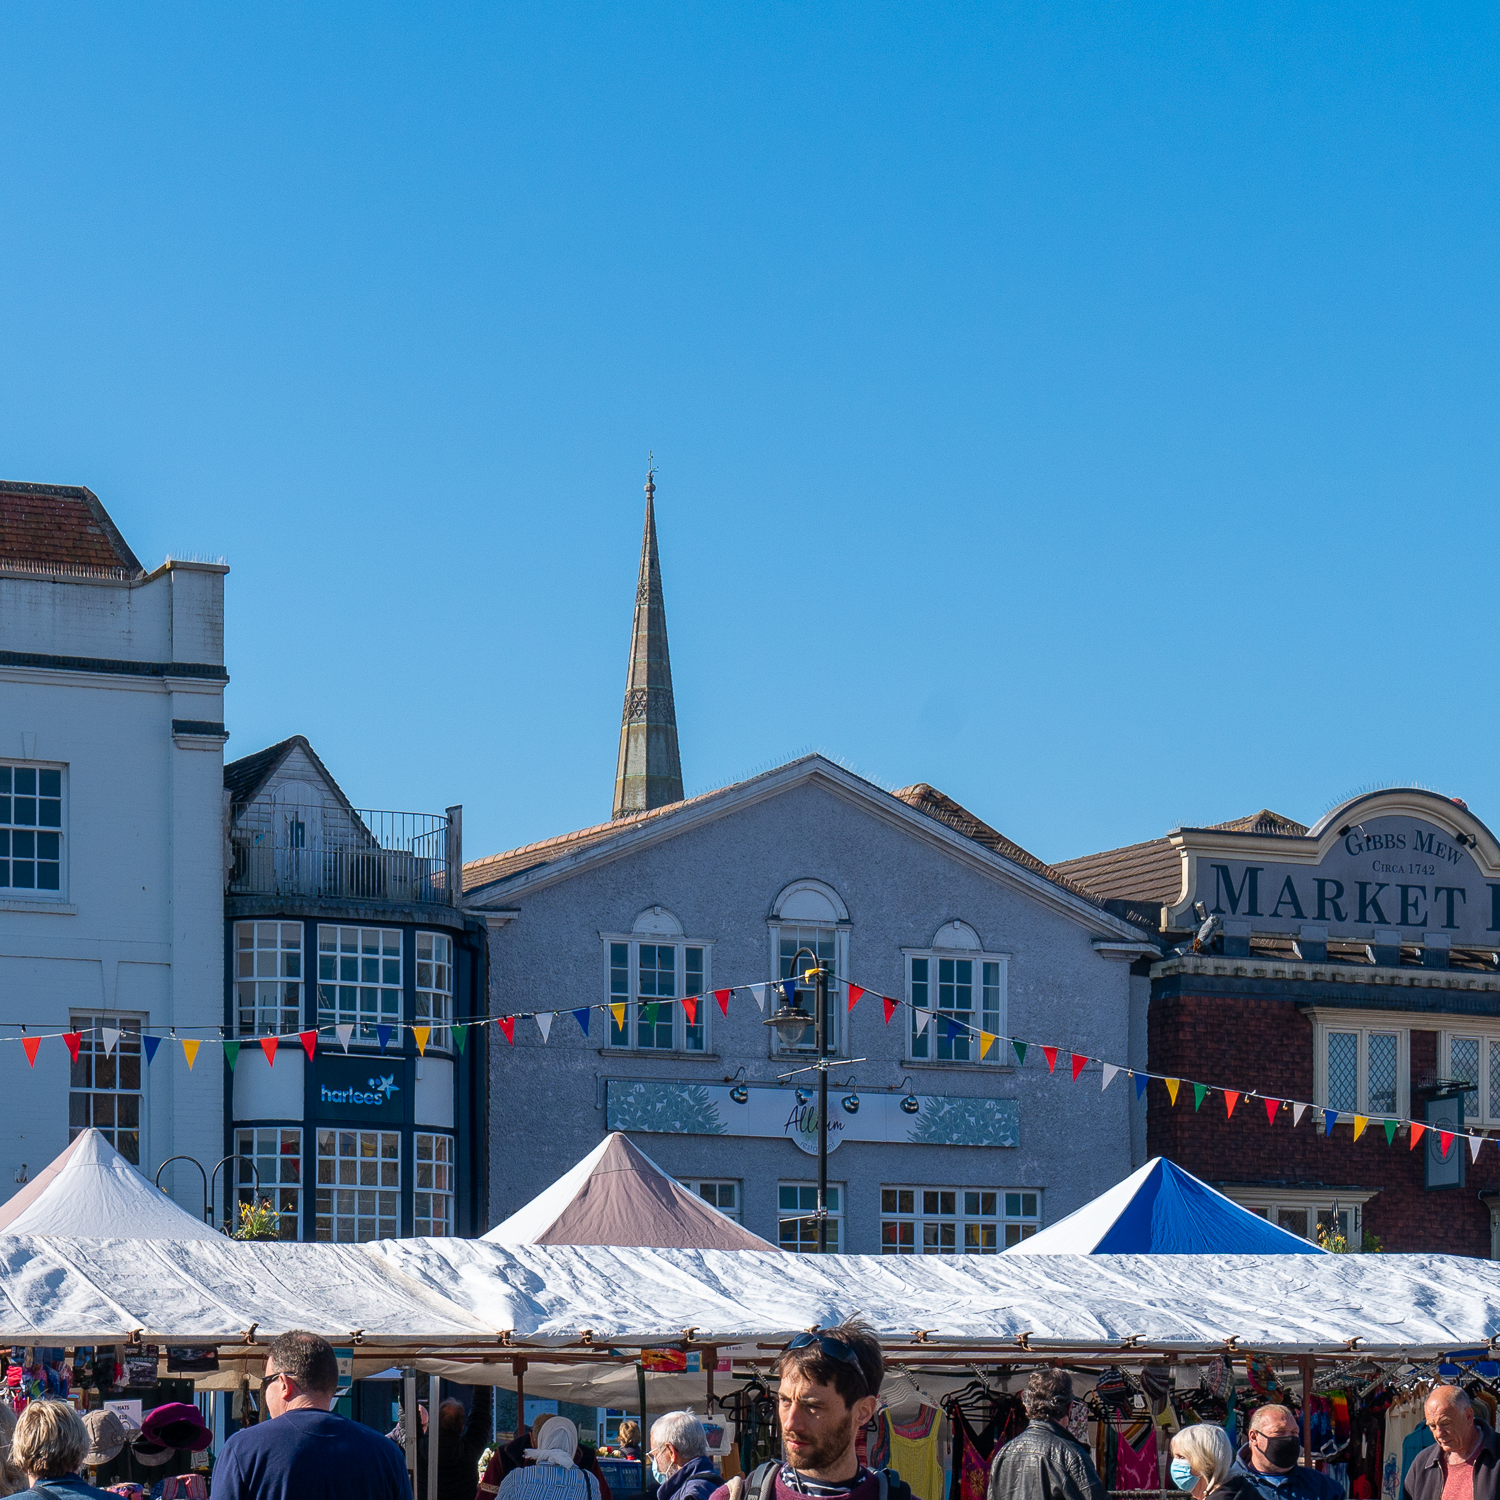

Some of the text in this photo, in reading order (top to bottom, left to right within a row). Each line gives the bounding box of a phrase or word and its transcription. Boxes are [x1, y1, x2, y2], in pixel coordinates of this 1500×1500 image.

[1345, 829, 1464, 866] GIBBS MEW
[1372, 860, 1435, 876] CIRCA 1742
[1210, 863, 1467, 930] MARKET
[320, 1083, 383, 1106] harlees
